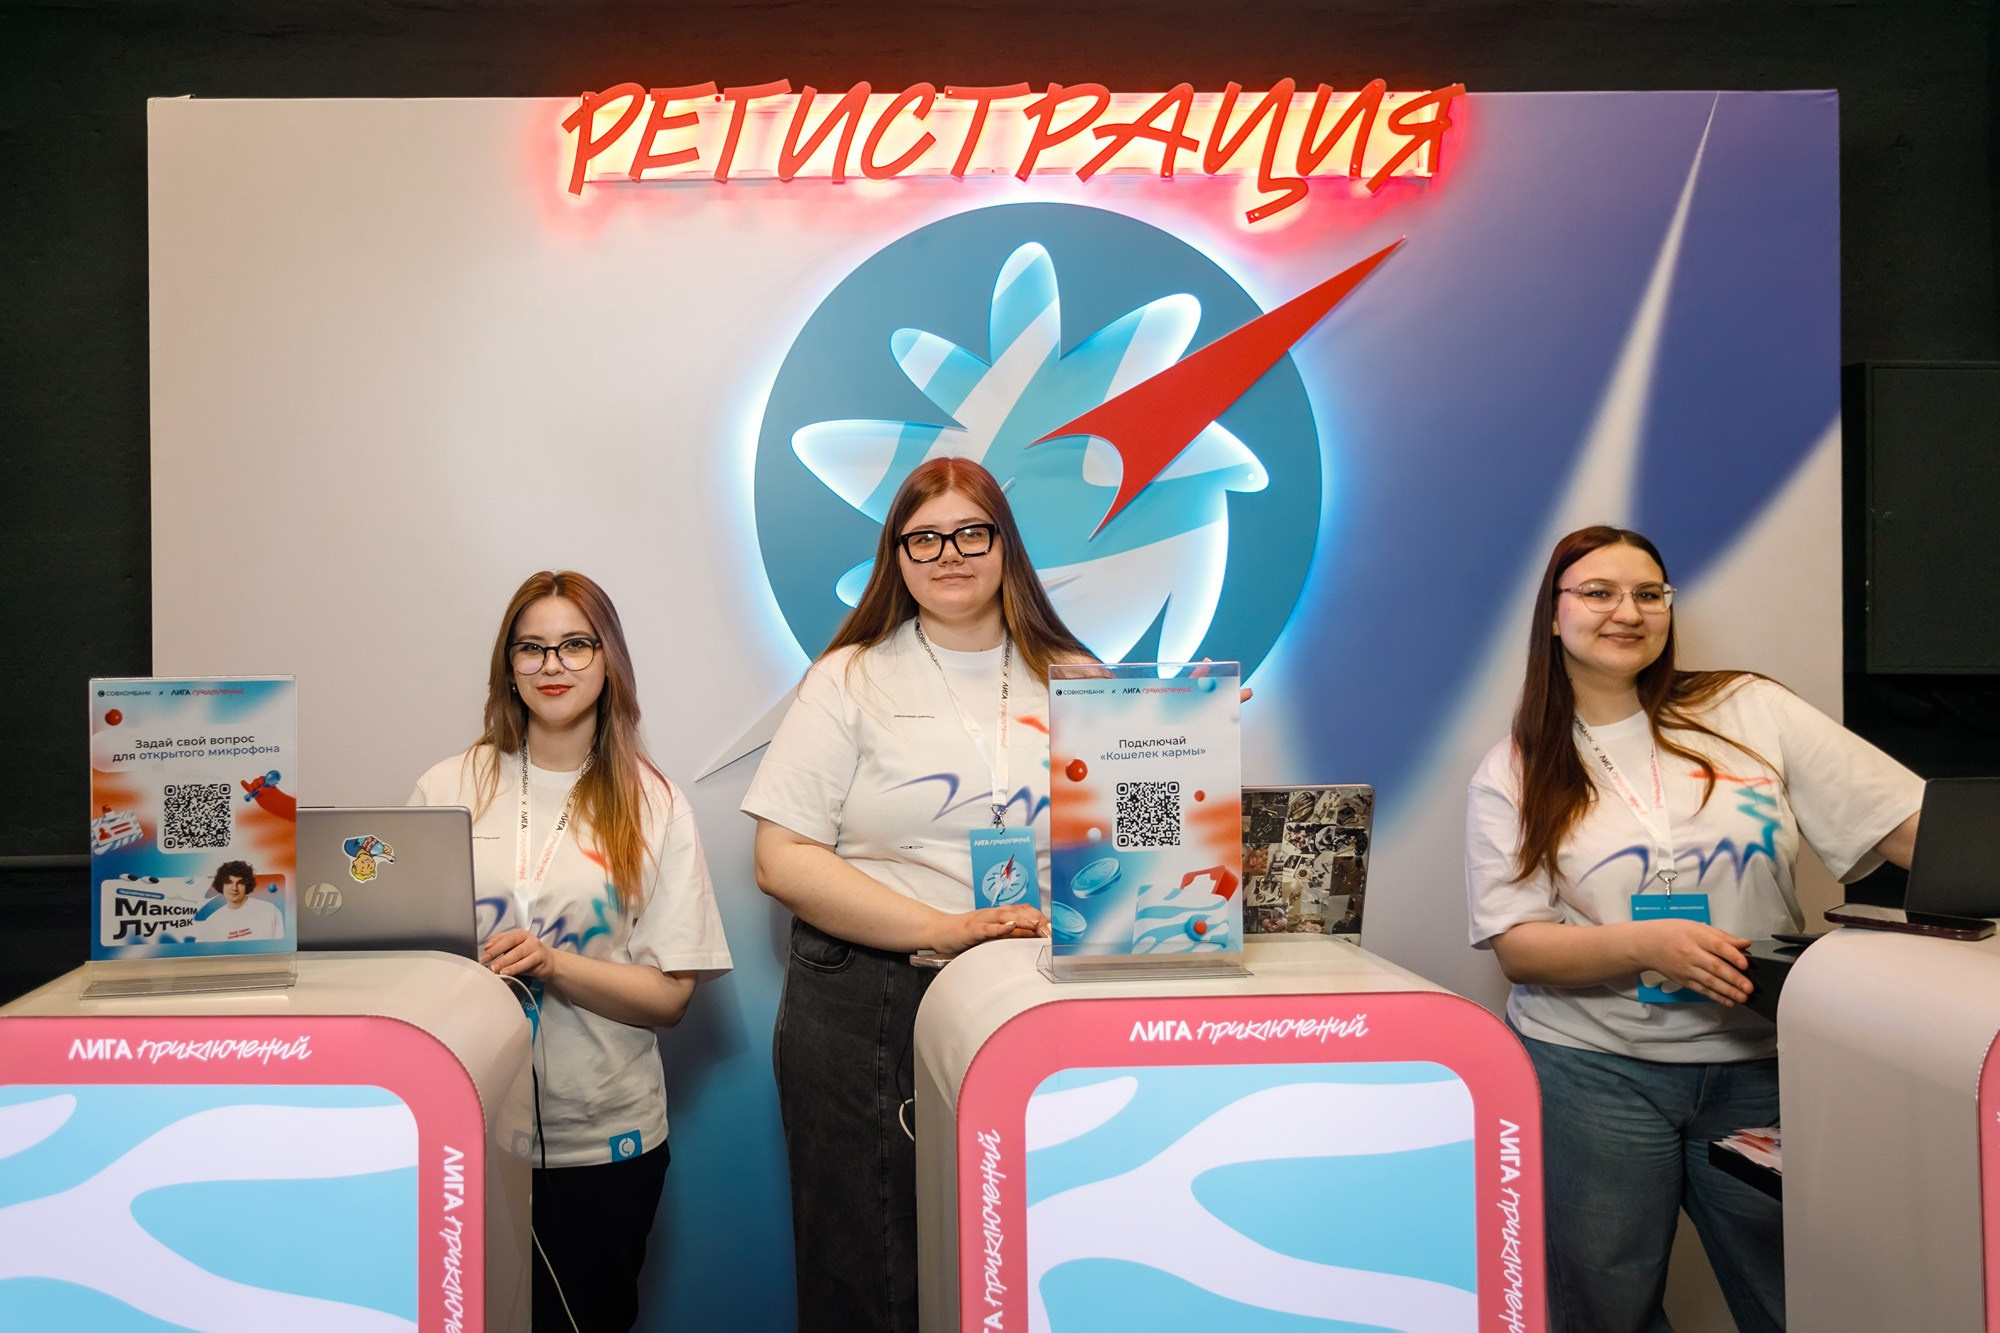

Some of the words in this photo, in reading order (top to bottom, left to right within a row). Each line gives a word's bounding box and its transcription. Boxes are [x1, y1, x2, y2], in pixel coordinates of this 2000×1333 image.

[562, 78, 1467, 225] РЕГИСТРАЦИЯ
[917, 629, 943, 671] СОВКОМБА
[106, 689, 151, 697] СОВКОМБАНК
[1122, 687, 1141, 695] ЛИГА
[112, 752, 136, 763] для
[139, 748, 205, 761] открытого
[208, 743, 280, 757] микрофона
[135, 736, 173, 749] Задай
[176, 735, 206, 747] свой
[210, 735, 255, 748] вопрос
[1118, 735, 1187, 750] Подключай
[1100, 750, 1159, 762] «Кошелек
[1162, 747, 1206, 760] кармы»
[115, 897, 198, 916] Максим
[308, 882, 339, 917] hp
[113, 919, 194, 940] Лутчак
[1128, 1019, 1193, 1042] ЛИГА
[67, 1038, 133, 1060] ЛИГА
[1499, 1118, 1521, 1184] ЛИГА
[443, 1144, 465, 1212] ЛИГА
[1496, 1187, 1526, 1333] приключен
[438, 1215, 464, 1333] приключе
